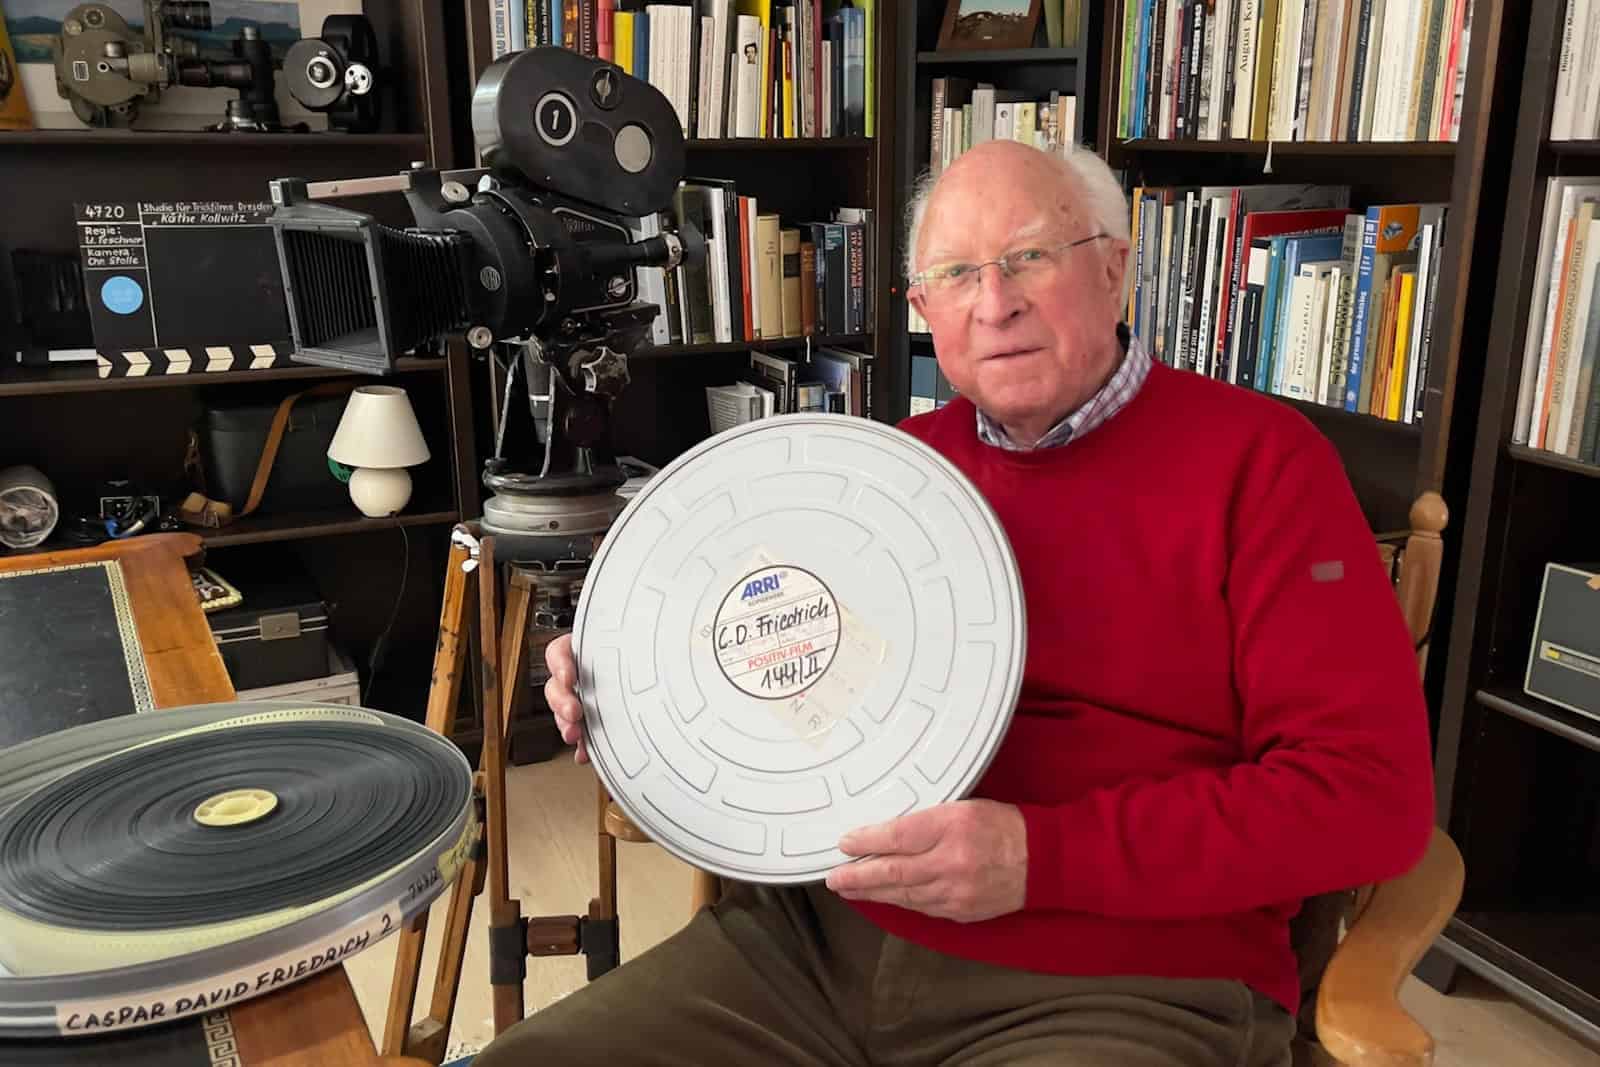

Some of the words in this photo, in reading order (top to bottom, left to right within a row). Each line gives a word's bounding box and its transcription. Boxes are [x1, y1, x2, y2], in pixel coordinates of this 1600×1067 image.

[1240, 28, 1250, 73] August
[86, 204, 125, 219] 4720
[200, 212, 247, 224] Kollwitz
[741, 574, 780, 600] ARRI
[756, 597, 829, 637] Friedrich
[66, 1003, 165, 1031] CASPAR
[175, 982, 249, 1014] DAVID
[256, 930, 370, 991] FRIEDRICH
[381, 913, 393, 935] 2
